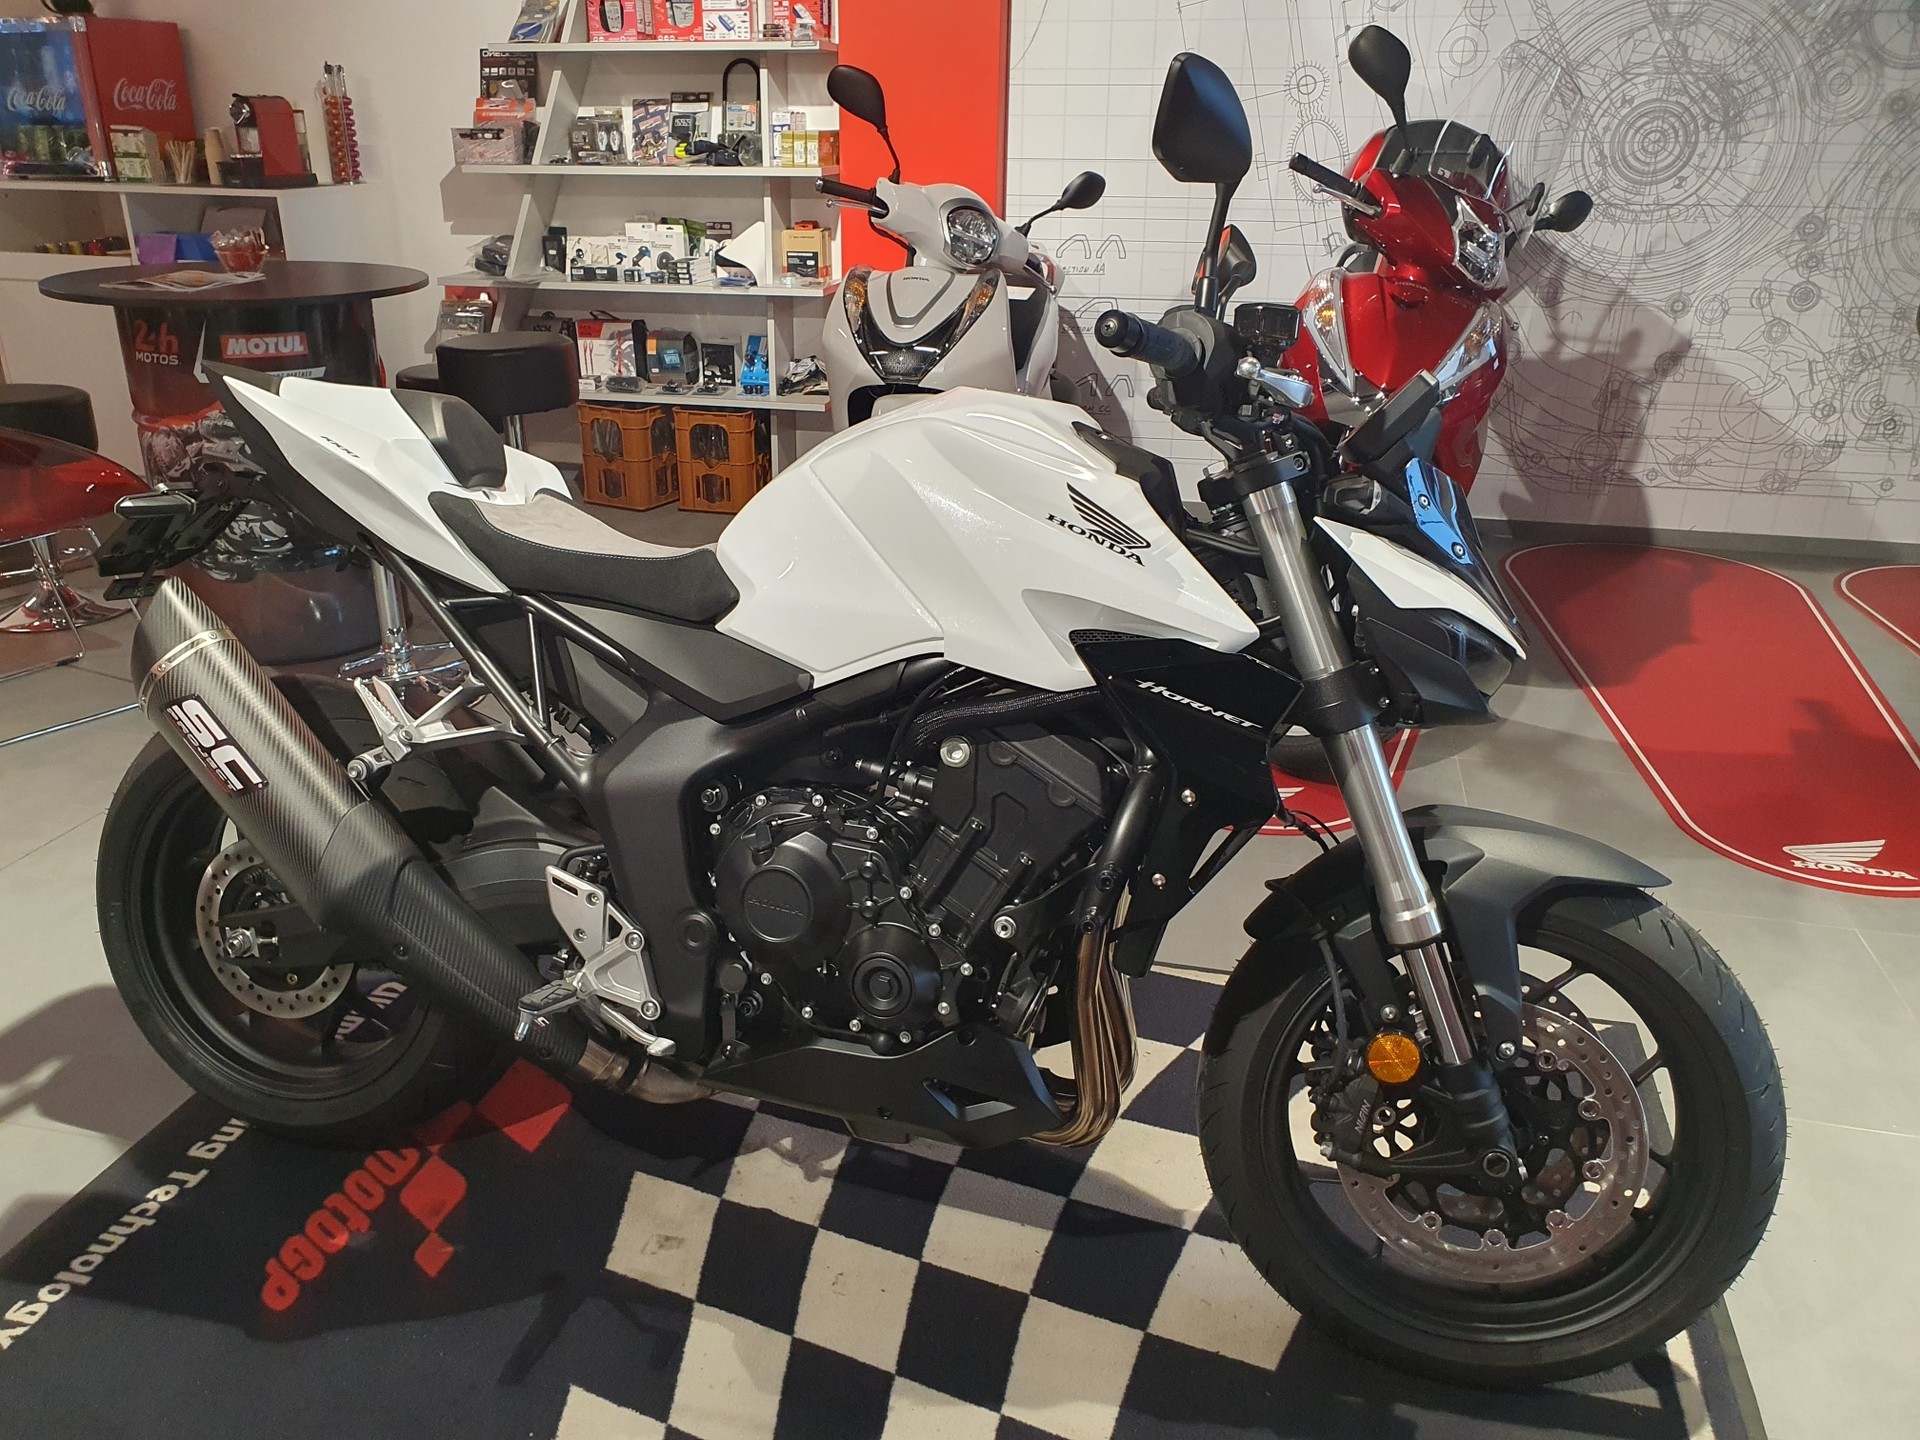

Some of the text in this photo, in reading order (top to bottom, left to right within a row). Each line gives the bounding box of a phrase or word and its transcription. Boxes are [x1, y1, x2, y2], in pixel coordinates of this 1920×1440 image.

[7, 84, 66, 112] Coca-Cola
[113, 77, 178, 111] Coca-Cola
[1062, 265, 1090, 274] ECTION
[135, 351, 179, 366] MOTOS
[226, 335, 304, 355] MOTUL
[1044, 512, 1146, 567] HONDA
[1135, 678, 1263, 729] HORNET
[166, 707, 238, 792] PROJECT
[171, 699, 263, 790] SC
[1790, 859, 1919, 881] HONDA
[0, 1167, 211, 1350] Technology
